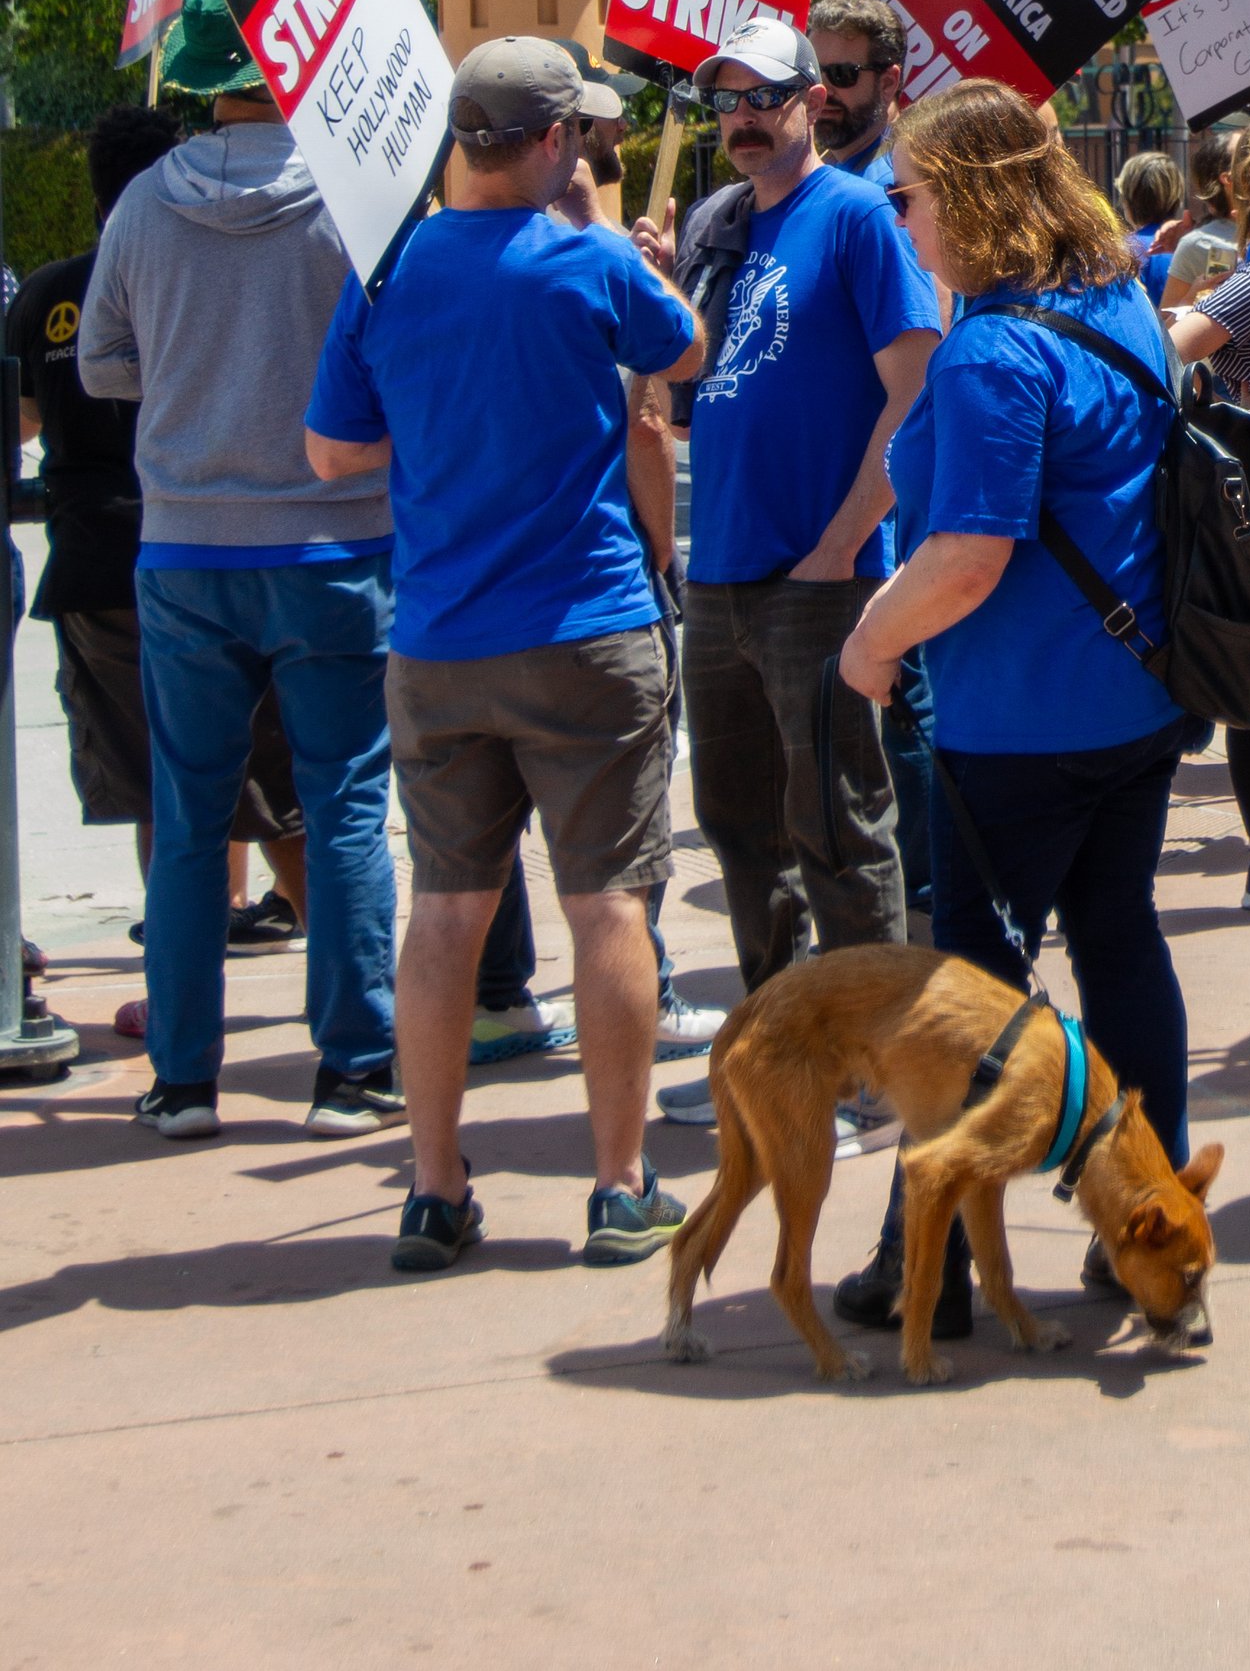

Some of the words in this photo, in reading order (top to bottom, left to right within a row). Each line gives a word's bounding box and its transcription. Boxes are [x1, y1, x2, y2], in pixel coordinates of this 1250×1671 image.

[943, 10, 990, 62] ON
[1158, 0, 1205, 37] It's
[316, 26, 370, 138] KEEP
[346, 28, 412, 166] HOLLYWOOD
[381, 68, 433, 177] HUMAN
[758, 252, 778, 270] OF
[763, 283, 790, 362] AMERICA
[45, 345, 76, 364] PEACE
[705, 381, 726, 393] WEST
